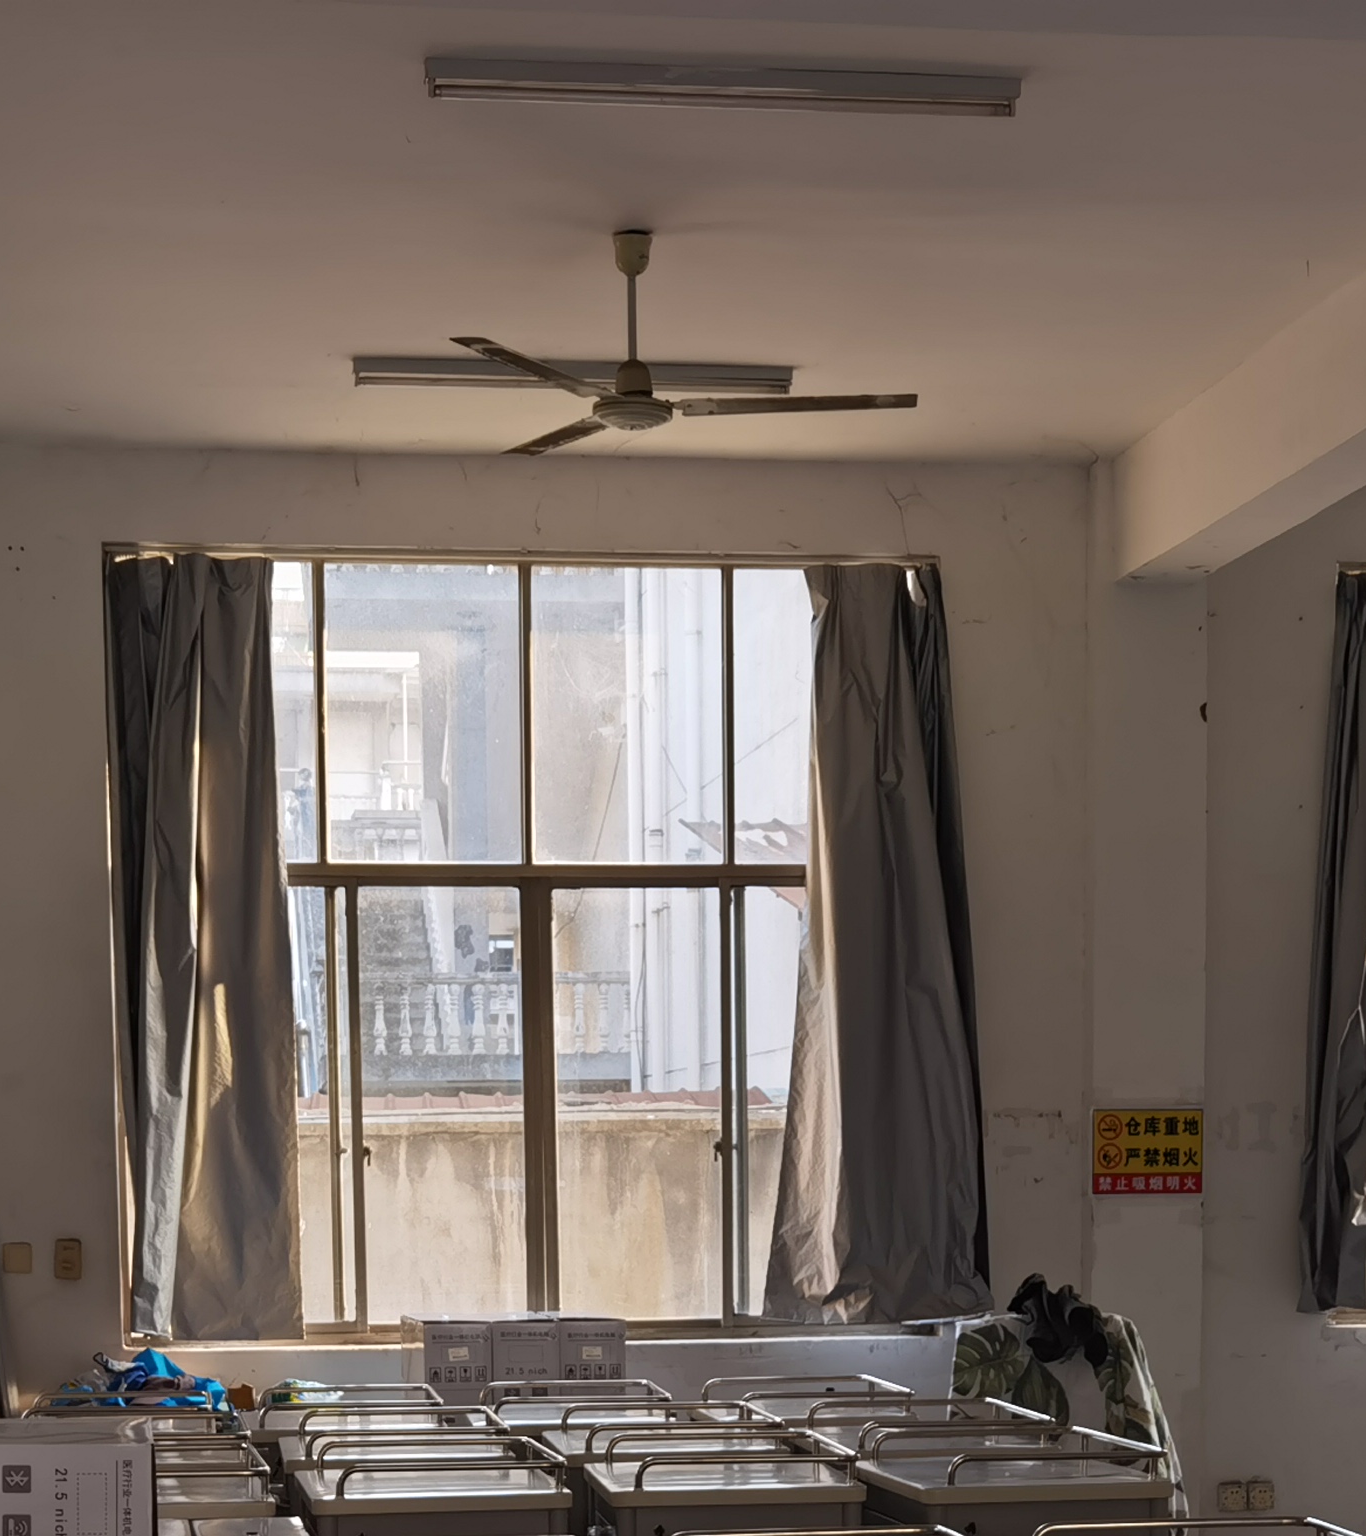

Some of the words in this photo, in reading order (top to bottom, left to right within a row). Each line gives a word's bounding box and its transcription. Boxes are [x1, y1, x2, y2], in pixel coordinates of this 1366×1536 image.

[1125, 1116, 1199, 1136] 仓库重地
[1124, 1148, 1199, 1167] 严禁烟火
[1099, 1176, 1197, 1191] 禁止吸烟明火
[55, 1468, 68, 1501] 21.5
